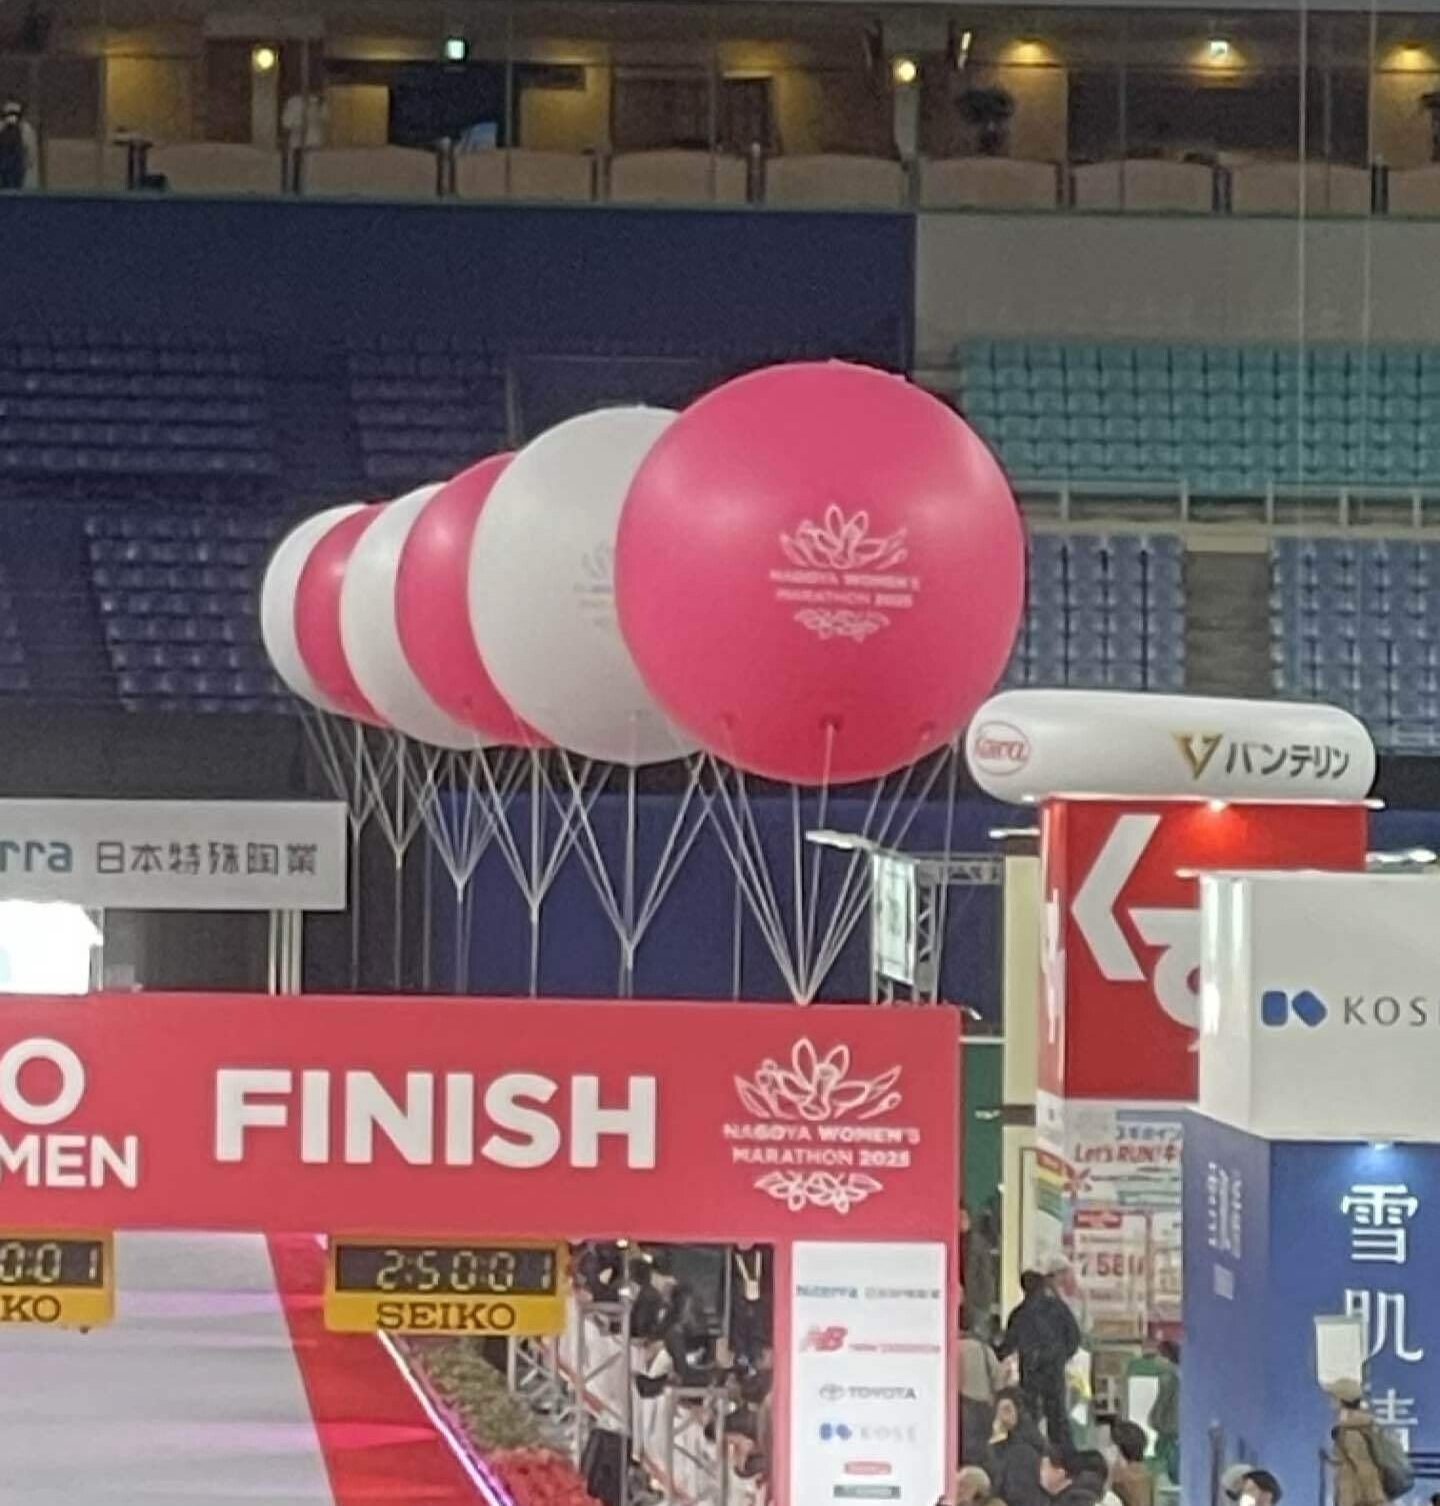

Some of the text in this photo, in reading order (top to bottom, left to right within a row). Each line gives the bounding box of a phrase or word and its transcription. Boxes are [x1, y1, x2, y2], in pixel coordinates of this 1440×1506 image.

[1225, 740, 1350, 780] バンテリン
[95, 840, 319, 876] 日本特殊陶業
[214, 1068, 657, 1170] FINISH
[722, 1122, 921, 1145] NAGOYA WOMEN'S
[731, 1146, 853, 1166] MARATHON
[376, 1301, 515, 1330] SEIKO
[848, 1386, 917, 1401] TOYOTA
